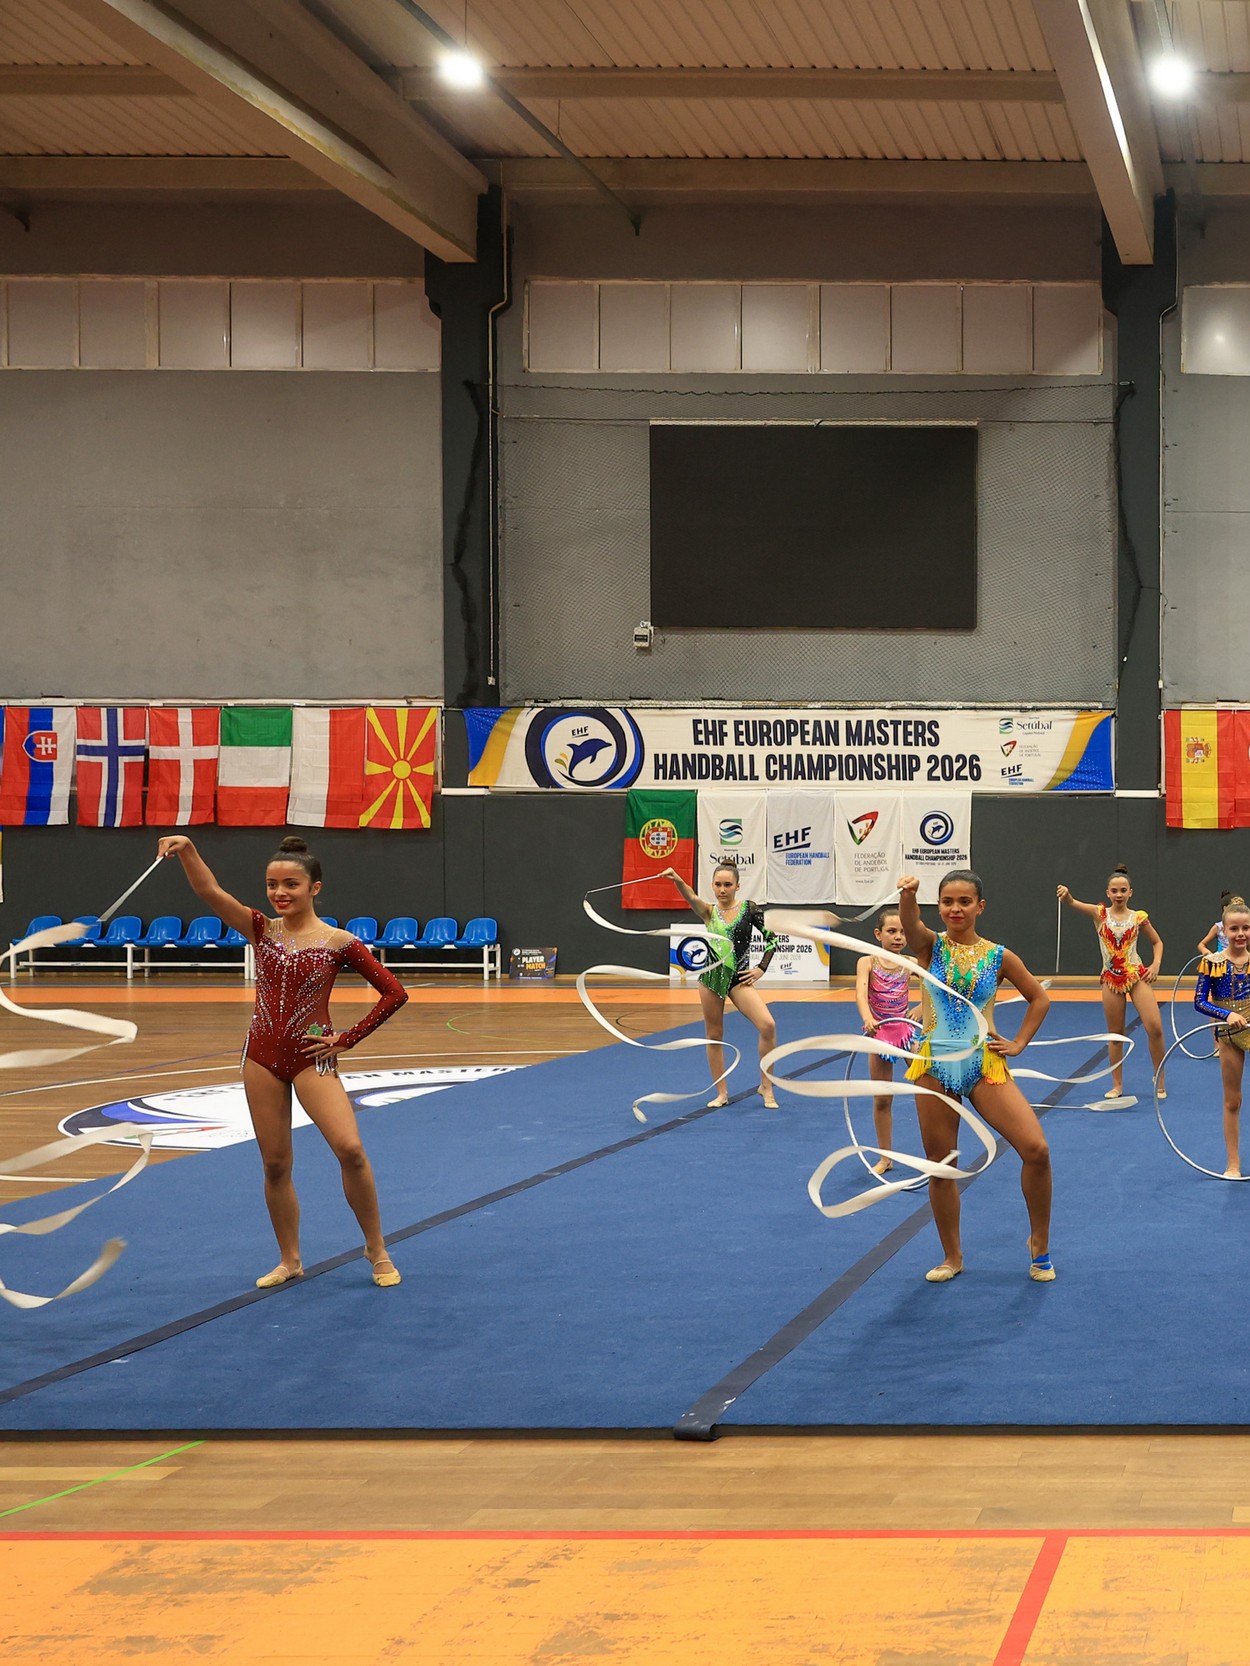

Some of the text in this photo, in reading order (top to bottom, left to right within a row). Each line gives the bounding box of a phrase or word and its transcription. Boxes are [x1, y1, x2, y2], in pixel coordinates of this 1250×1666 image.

[571, 726, 589, 736] EHF
[1016, 720, 1052, 731] Setúbal
[692, 719, 940, 747] EHF EUROPEAN MASTERS
[653, 753, 982, 782] HANDBALL CHAMPIONSHIP 2026
[1001, 764, 1022, 776] EHF
[773, 826, 811, 849] EHF
[854, 851, 886, 859] FEDERAÇÃO
[925, 854, 956, 862] CHAMPIONSHIP
[796, 945, 813, 953] 2026
